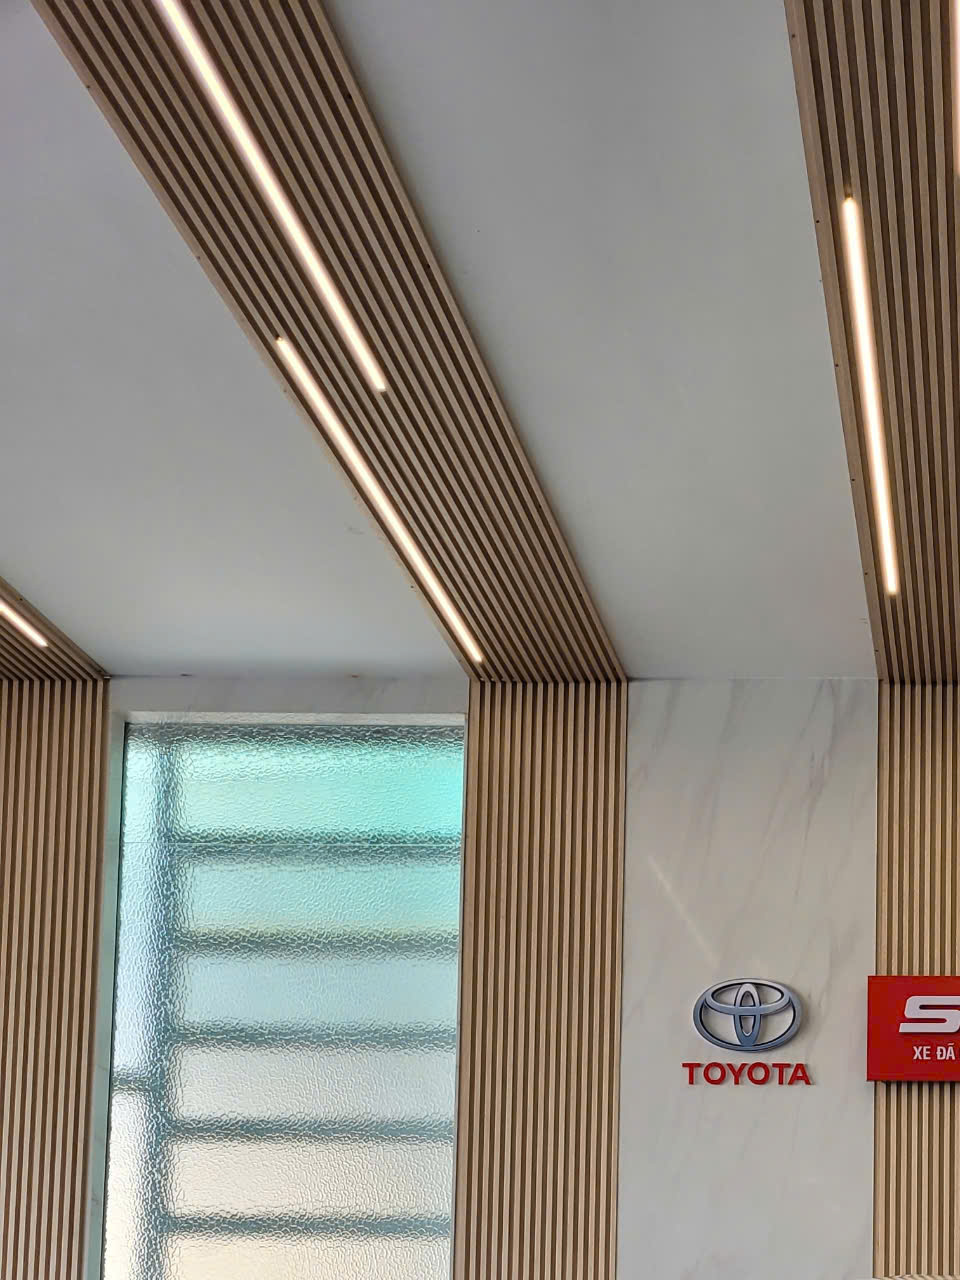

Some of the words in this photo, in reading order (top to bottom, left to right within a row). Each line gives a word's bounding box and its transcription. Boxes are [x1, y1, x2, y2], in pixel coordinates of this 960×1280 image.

[913, 1046, 930, 1060] XE
[937, 1042, 955, 1060] ĐÃ
[682, 1062, 811, 1087] TOYOTA
